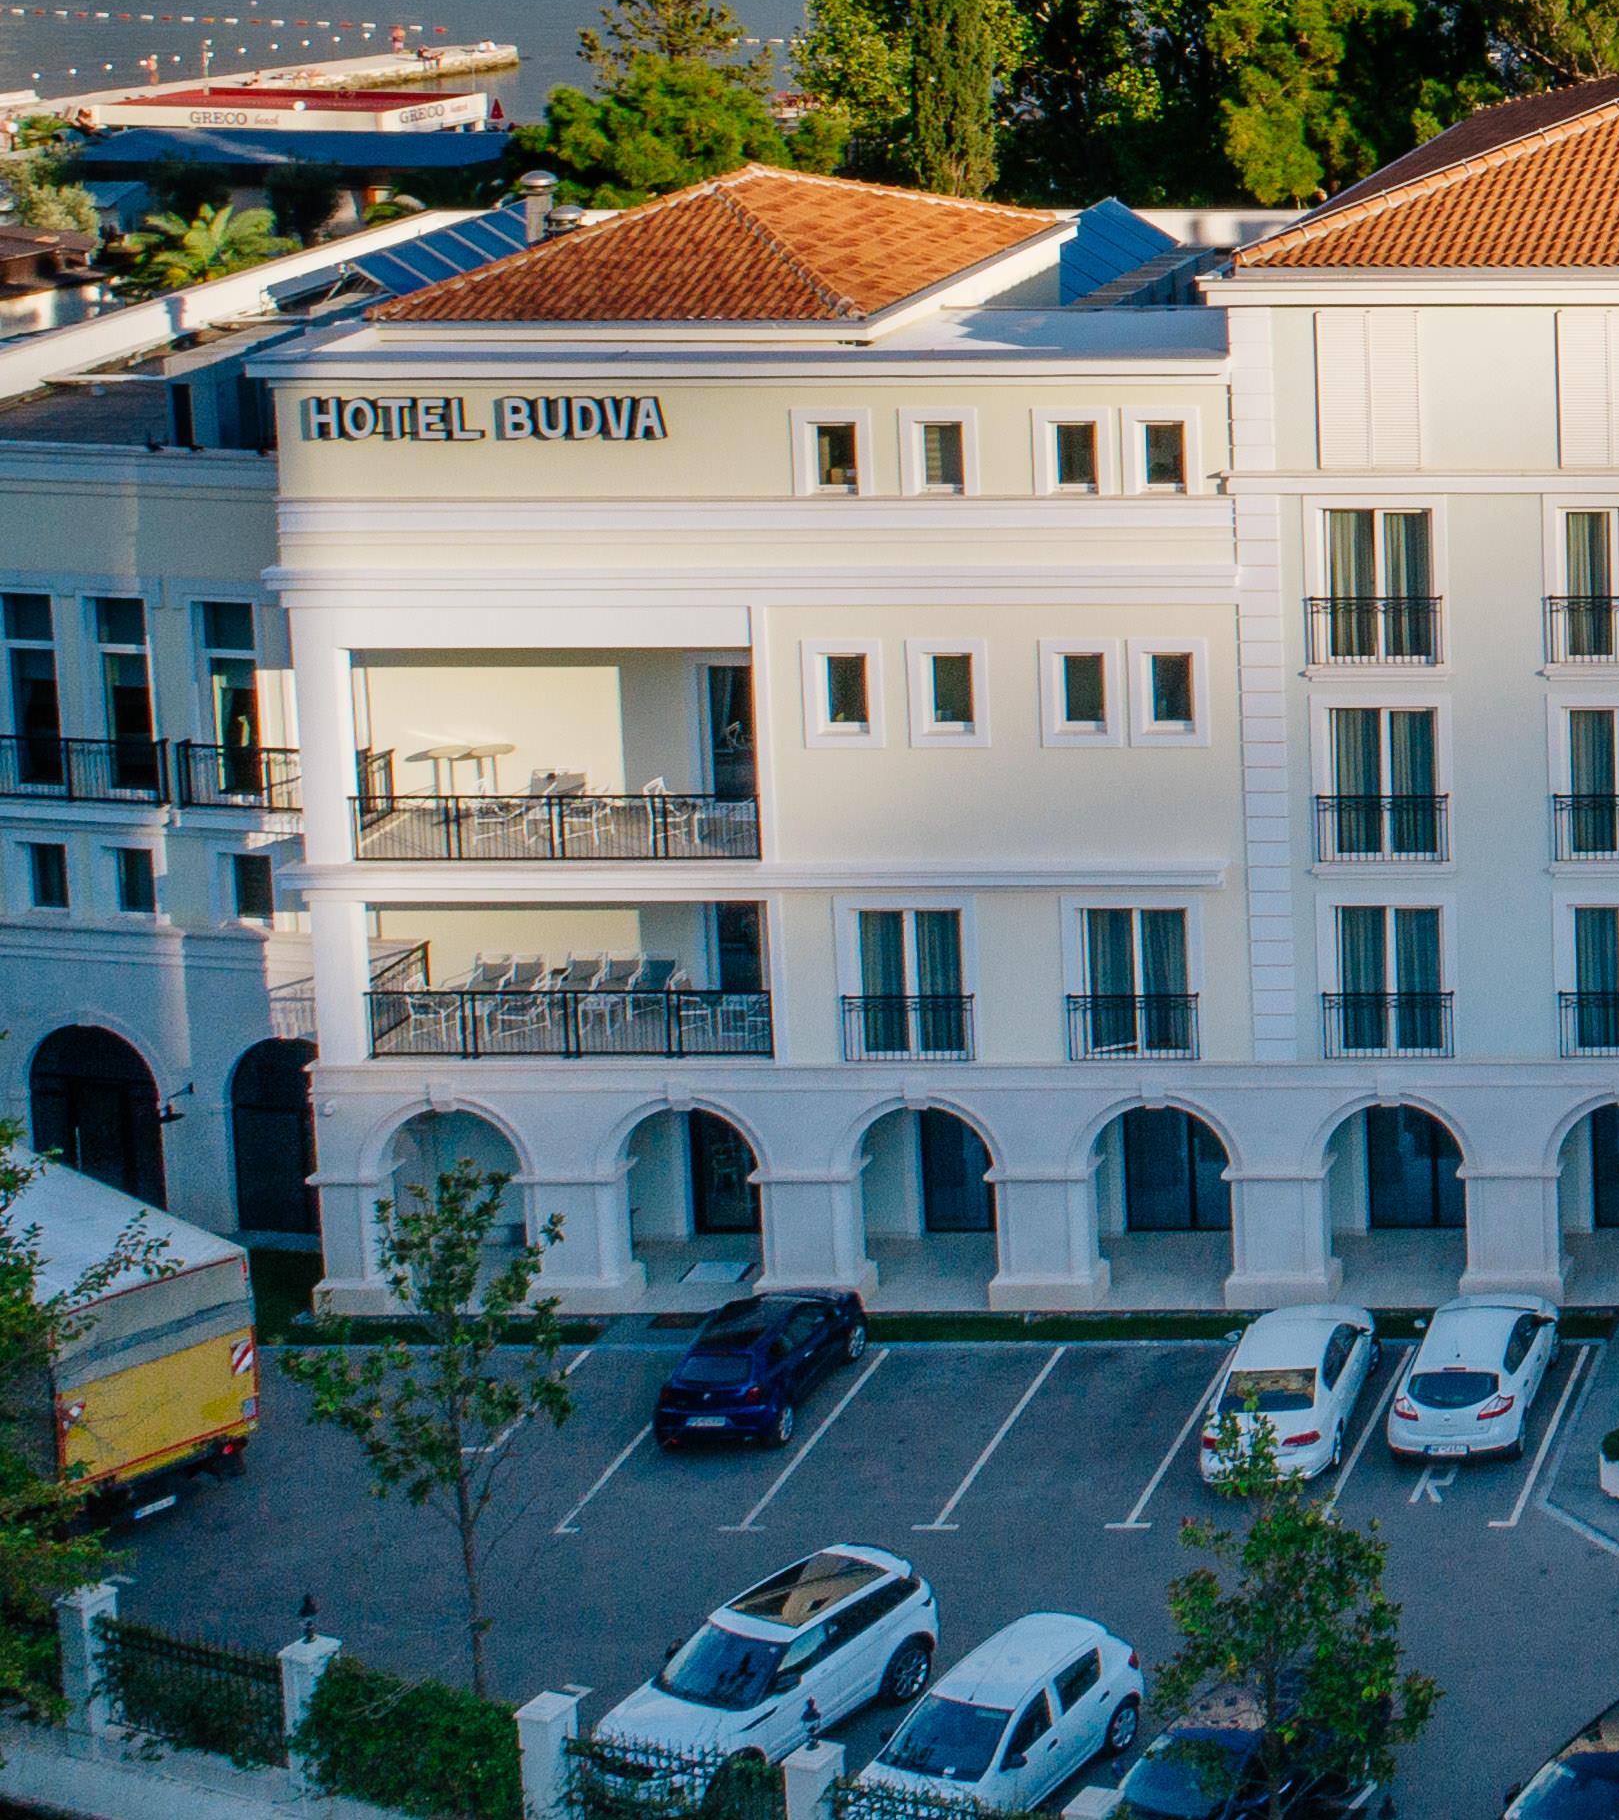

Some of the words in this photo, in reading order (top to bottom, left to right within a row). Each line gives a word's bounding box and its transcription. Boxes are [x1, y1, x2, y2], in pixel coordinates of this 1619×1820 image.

[190, 110, 248, 126] GRECO
[398, 103, 446, 124] GRECO
[306, 396, 486, 441] HOTEL
[501, 396, 668, 440] BUDVA
